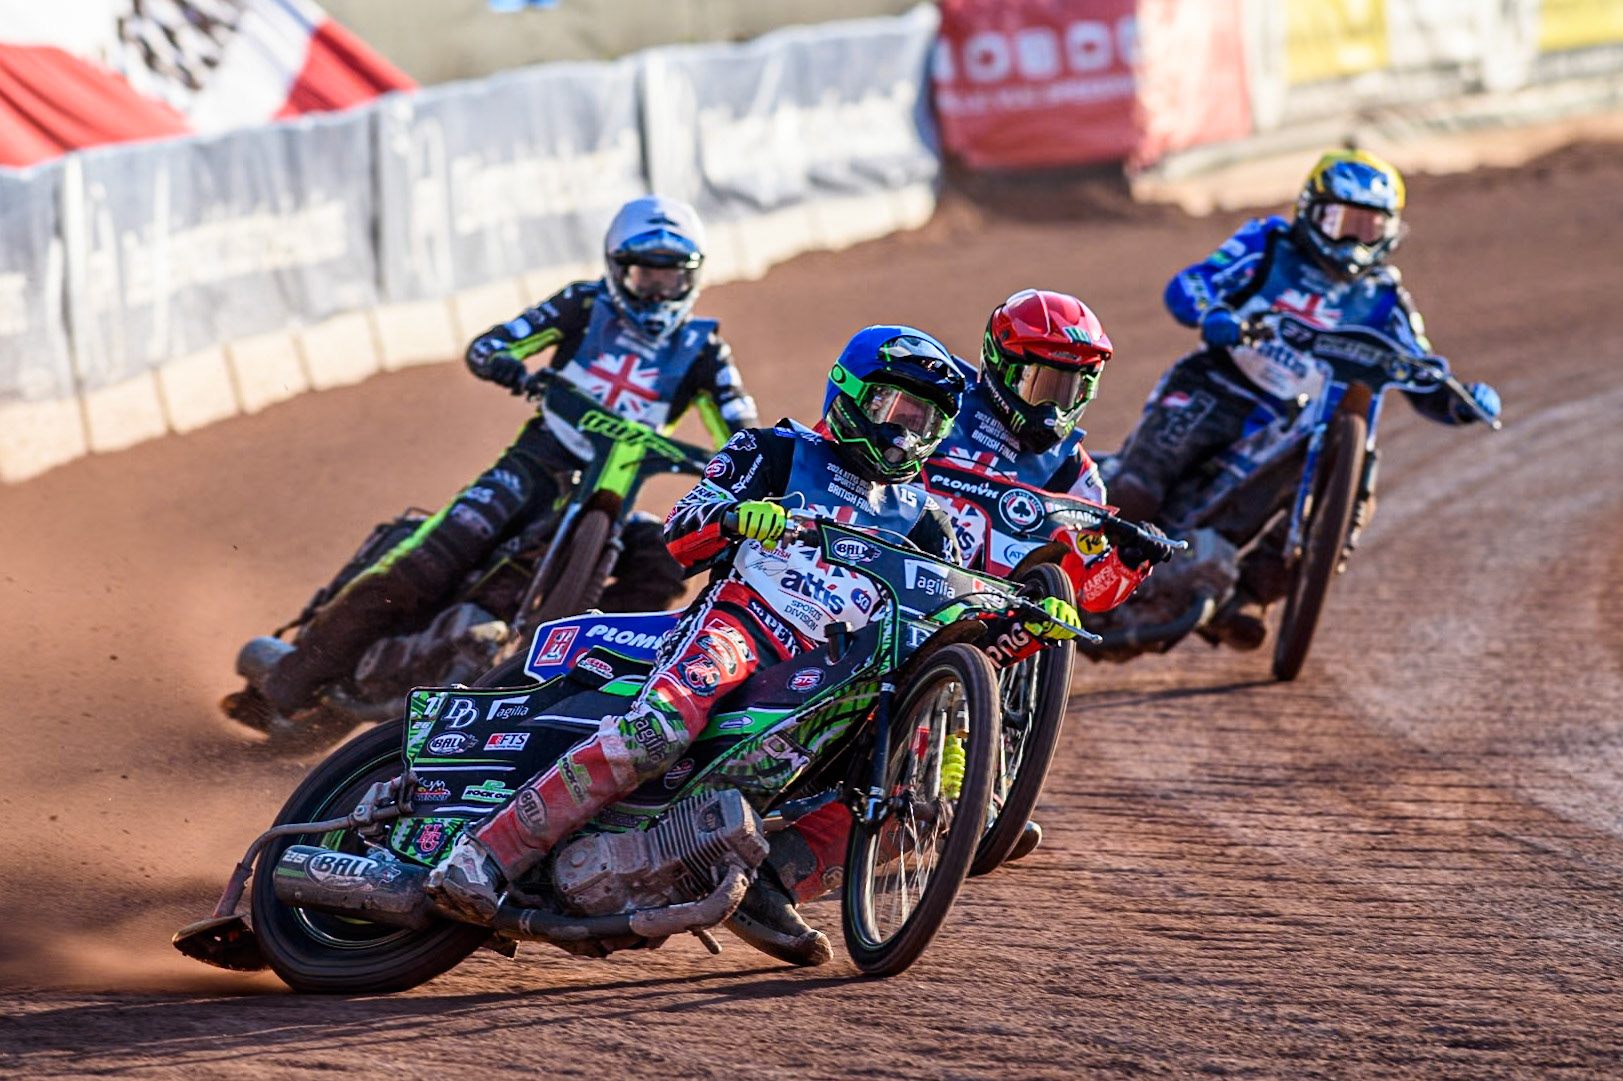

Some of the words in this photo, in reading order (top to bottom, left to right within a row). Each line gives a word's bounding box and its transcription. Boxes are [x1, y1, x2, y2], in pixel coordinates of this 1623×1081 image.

[972, 429, 1000, 451] BRITISH
[998, 444, 1018, 463] FINAL
[826, 462, 844, 475] 2024
[833, 474, 856, 490] SPORTS
[827, 482, 857, 505] BRITISH
[856, 497, 877, 517] FINAL
[900, 487, 918, 508] 15
[780, 569, 846, 615] attis
[916, 575, 956, 599] agilia
[784, 604, 821, 632] DIVISION
[791, 600, 824, 621] SPORTS
[496, 704, 530, 721] agilia
[500, 733, 527, 745] FTS
[634, 716, 668, 763] agilia
[561, 756, 577, 785] ROCK
[465, 790, 493, 798] ROCK
